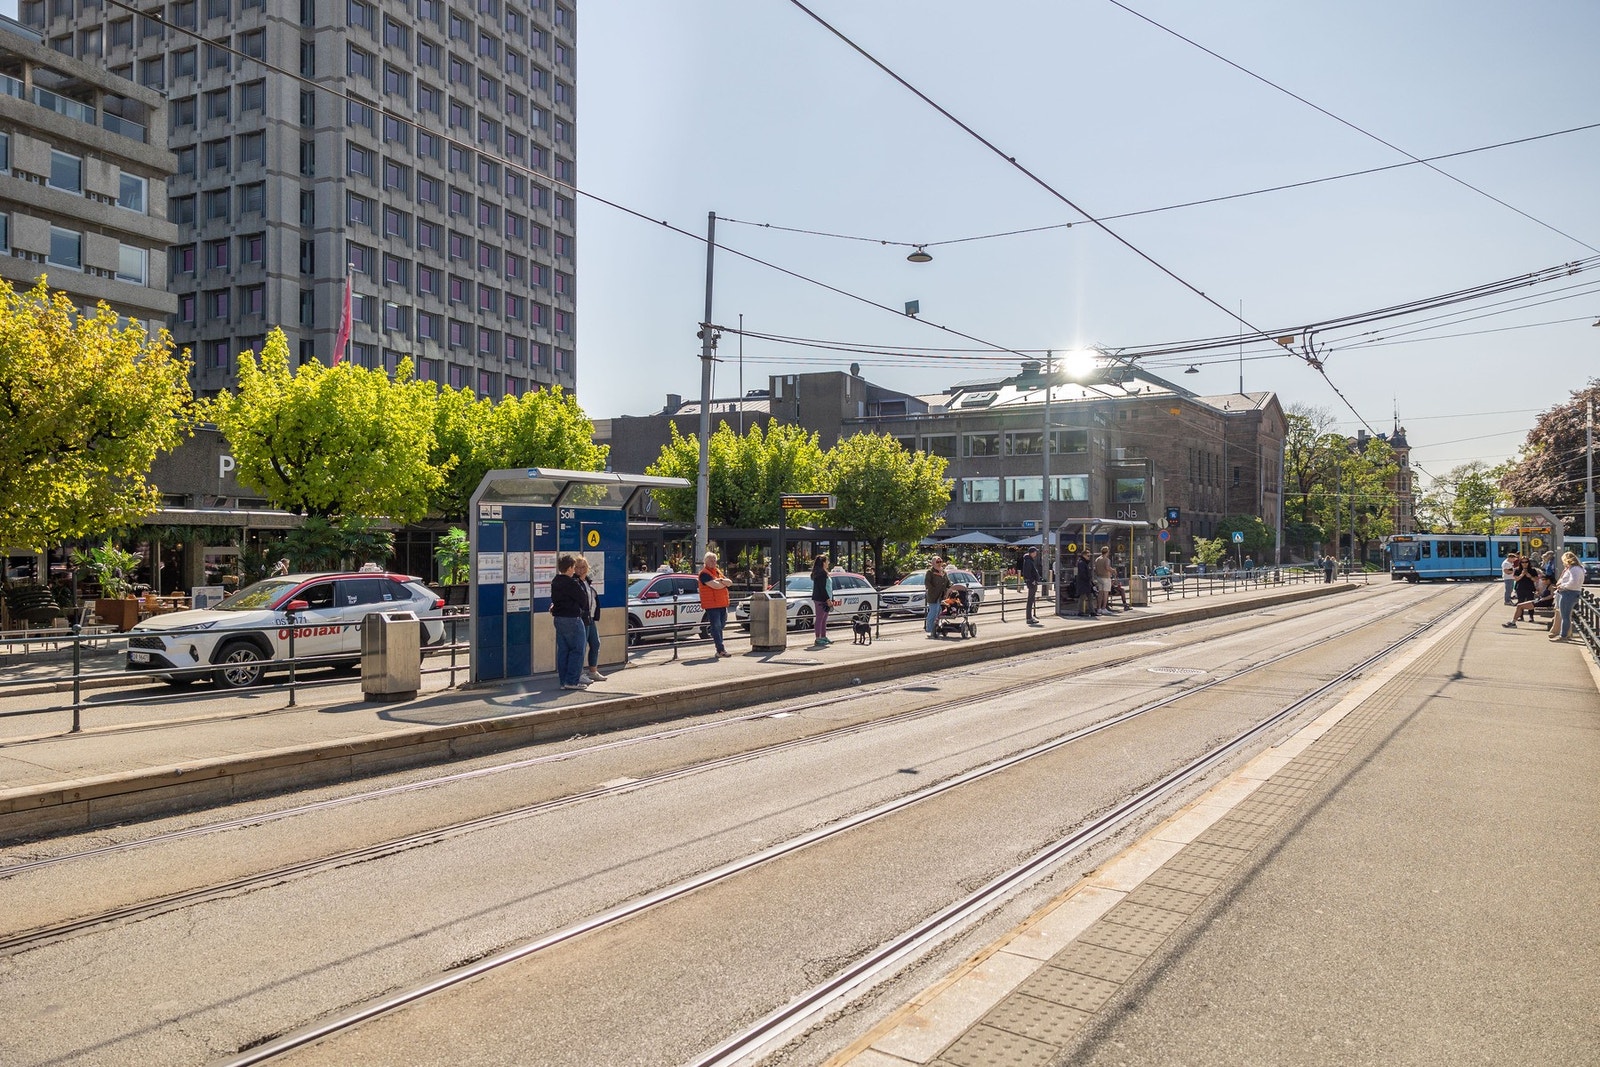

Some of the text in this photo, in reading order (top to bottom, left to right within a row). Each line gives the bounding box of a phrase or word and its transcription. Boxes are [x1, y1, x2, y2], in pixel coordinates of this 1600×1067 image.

[560, 509, 575, 519] Solli
[1117, 504, 1137, 520] DNB
[590, 533, 597, 543] A
[645, 607, 675, 619] OsloTax
